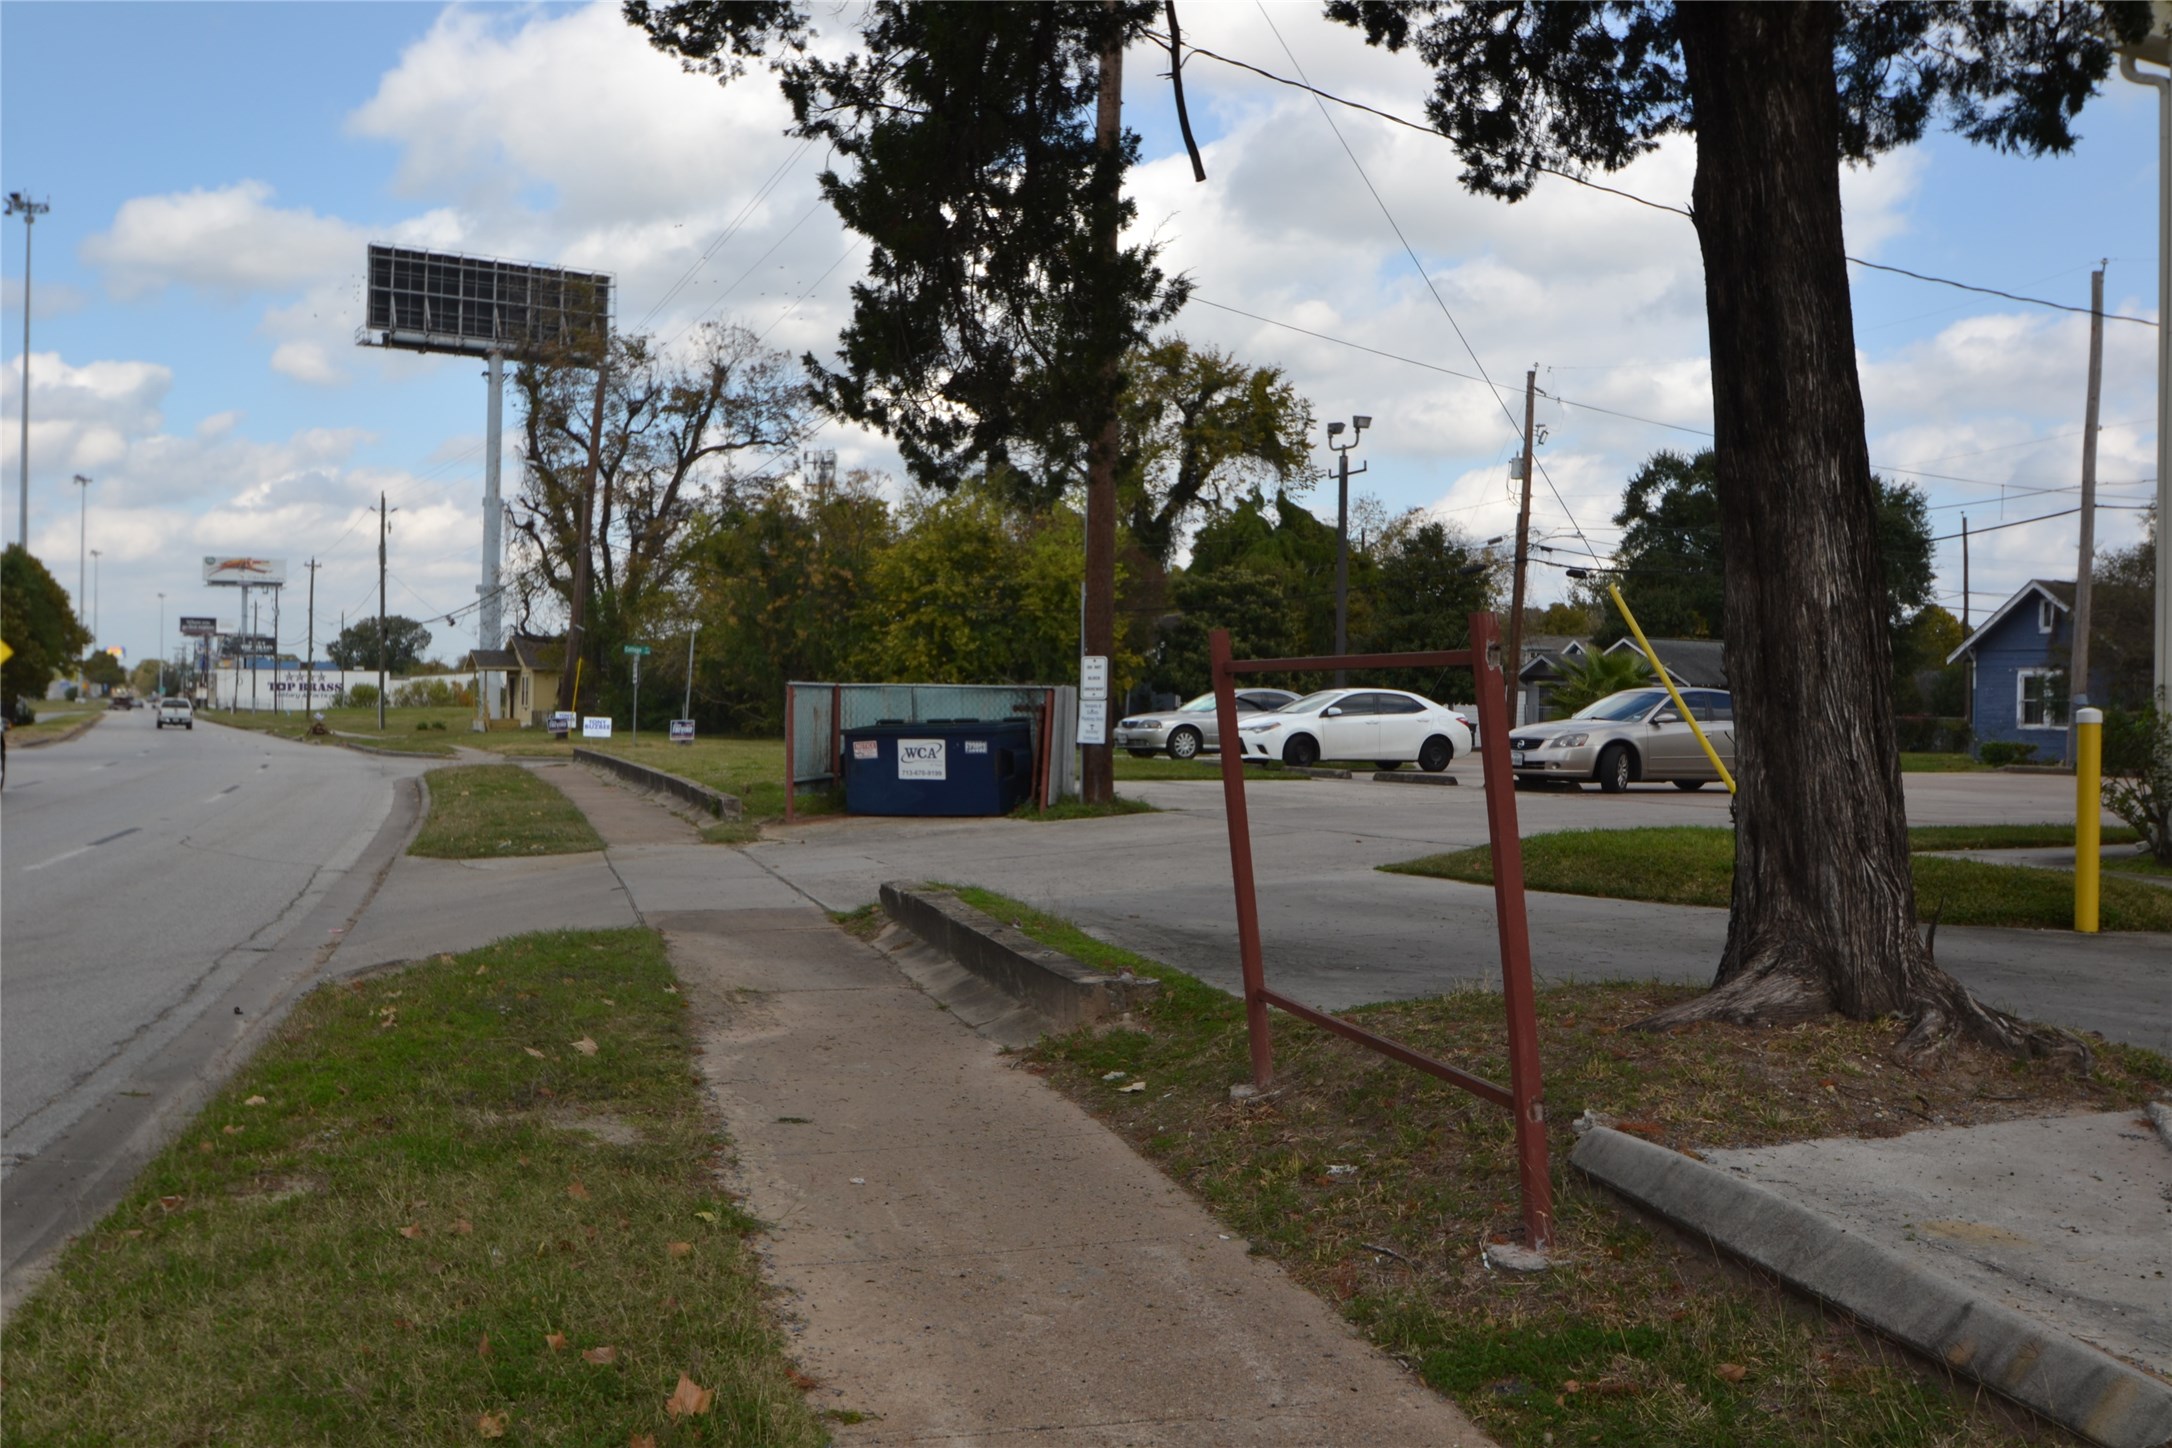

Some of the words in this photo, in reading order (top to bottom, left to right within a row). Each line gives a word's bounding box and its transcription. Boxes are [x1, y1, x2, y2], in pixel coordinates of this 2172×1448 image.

[267, 682, 296, 691] TOP
[299, 682, 343, 692] BRASS
[904, 746, 937, 759] WCA
